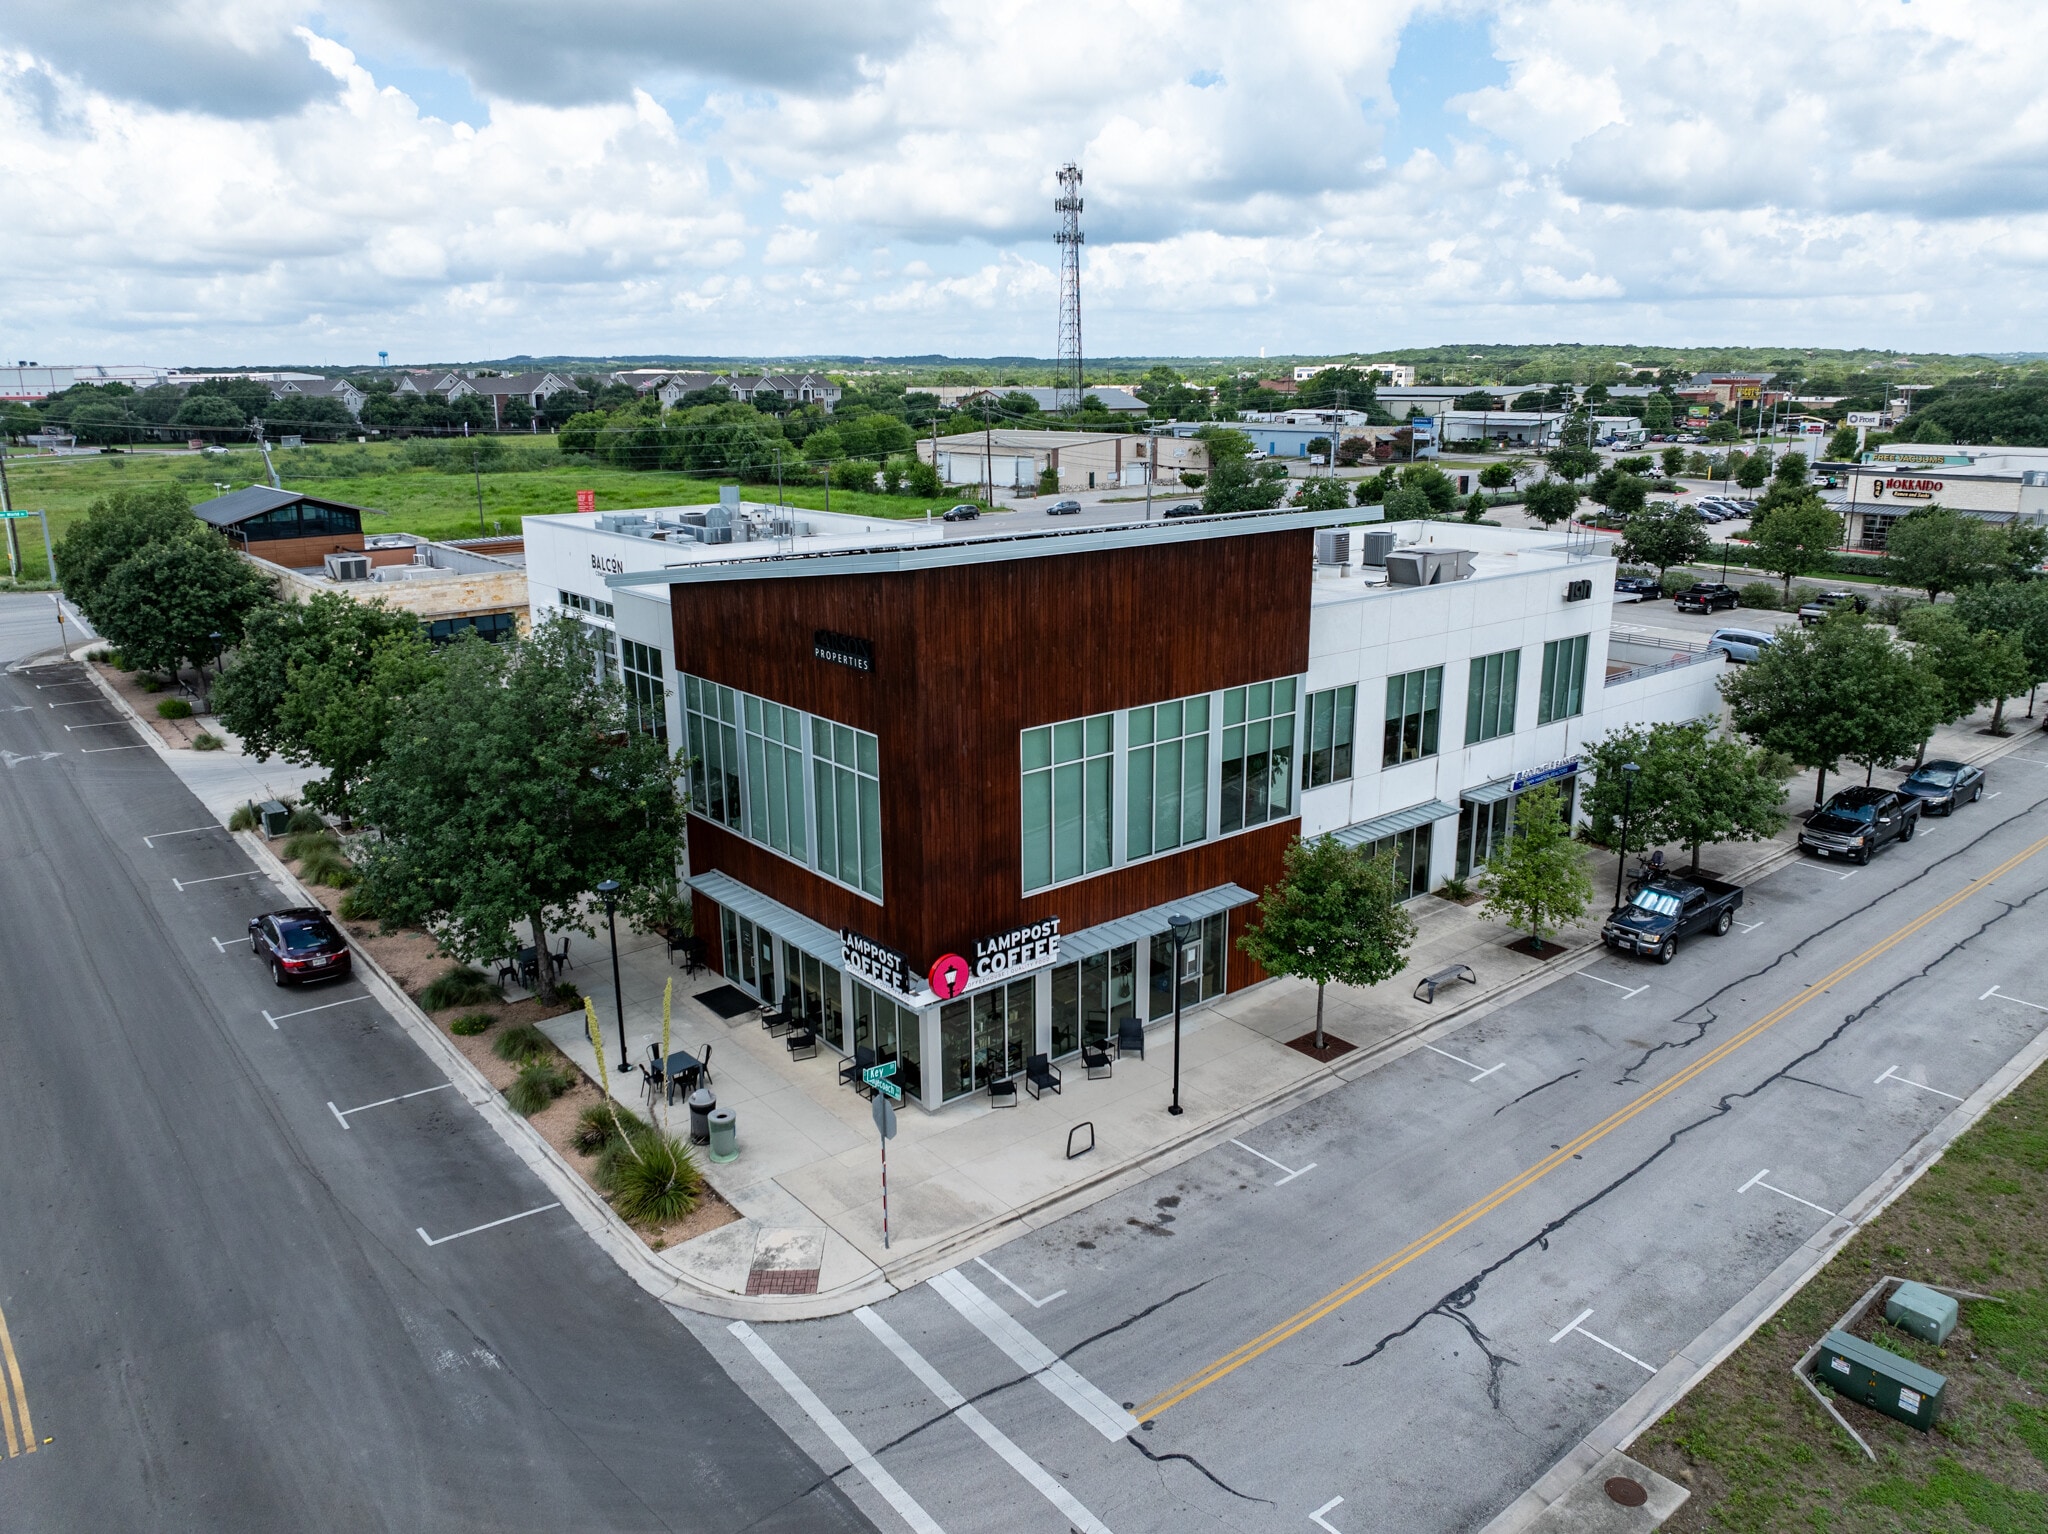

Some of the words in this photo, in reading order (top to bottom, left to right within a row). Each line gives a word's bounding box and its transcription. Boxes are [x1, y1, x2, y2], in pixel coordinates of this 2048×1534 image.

[1858, 415, 1876, 424] Frost
[1872, 454, 1896, 462] FREE
[1898, 455, 1945, 464] VACUUMS
[1886, 478, 1943, 492] HOKKAIDO
[815, 648, 868, 670] PROPERTIES
[976, 918, 1061, 958] LAMPPOST
[840, 929, 902, 972] LAMPPOST
[976, 934, 1061, 978] COFFEE
[841, 946, 904, 994] COFFEE
[870, 1068, 884, 1079] Key
